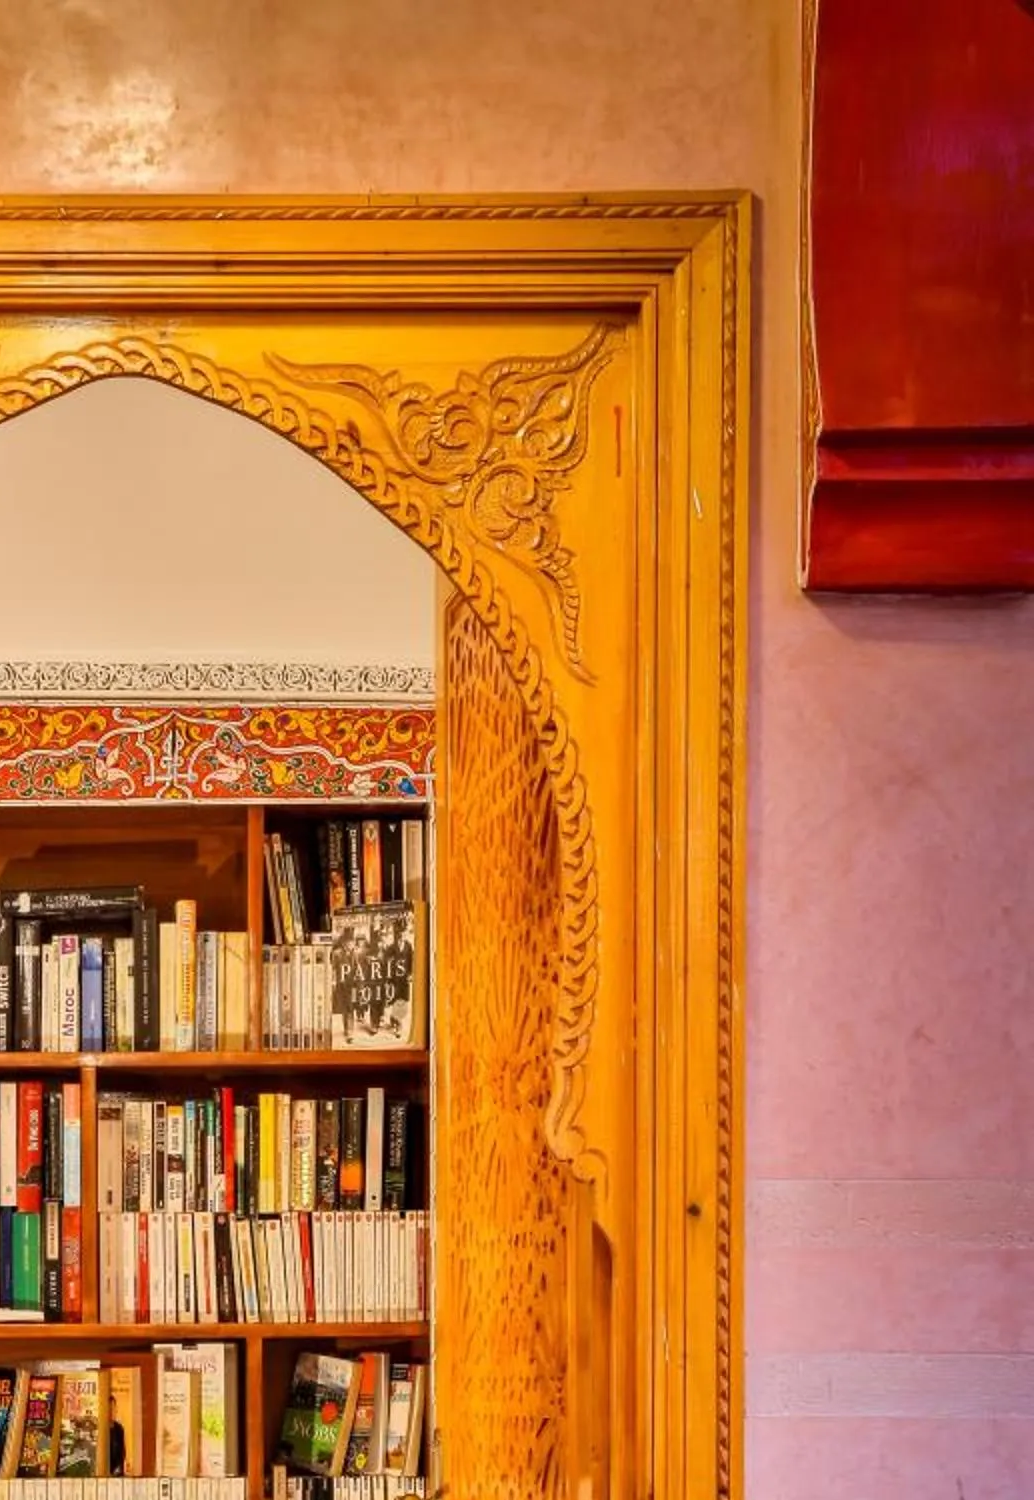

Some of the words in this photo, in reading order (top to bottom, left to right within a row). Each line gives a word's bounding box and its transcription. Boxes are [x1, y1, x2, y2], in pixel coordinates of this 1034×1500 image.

[341, 959, 406, 982] PARIS
[351, 983, 395, 1005] 1919
[61, 988, 75, 1036] Maroc
